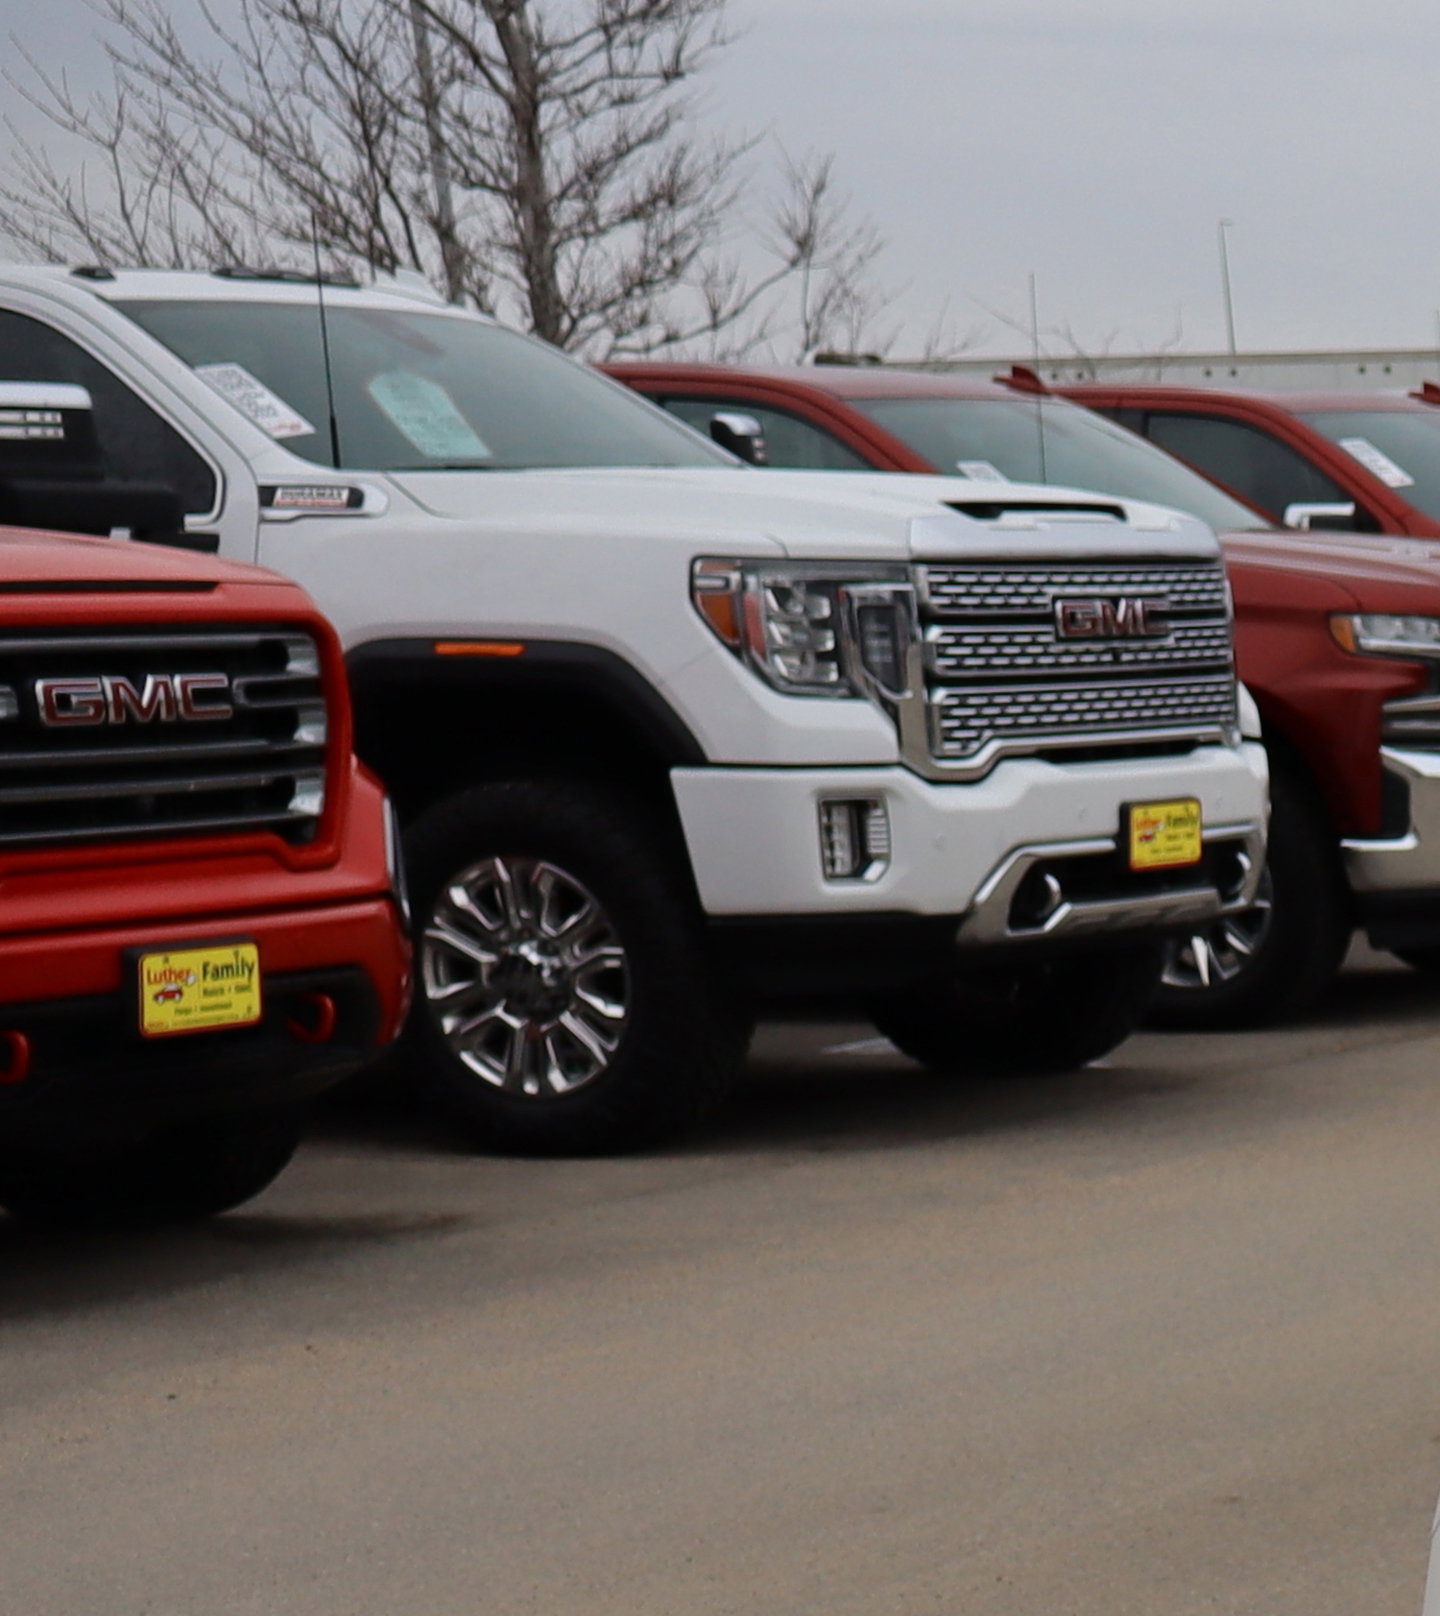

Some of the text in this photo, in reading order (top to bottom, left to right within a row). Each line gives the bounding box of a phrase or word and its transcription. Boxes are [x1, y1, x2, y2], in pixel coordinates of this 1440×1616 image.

[1055, 598, 1169, 638] GMC
[35, 673, 233, 726] GMC
[147, 955, 254, 984] Luther Family
